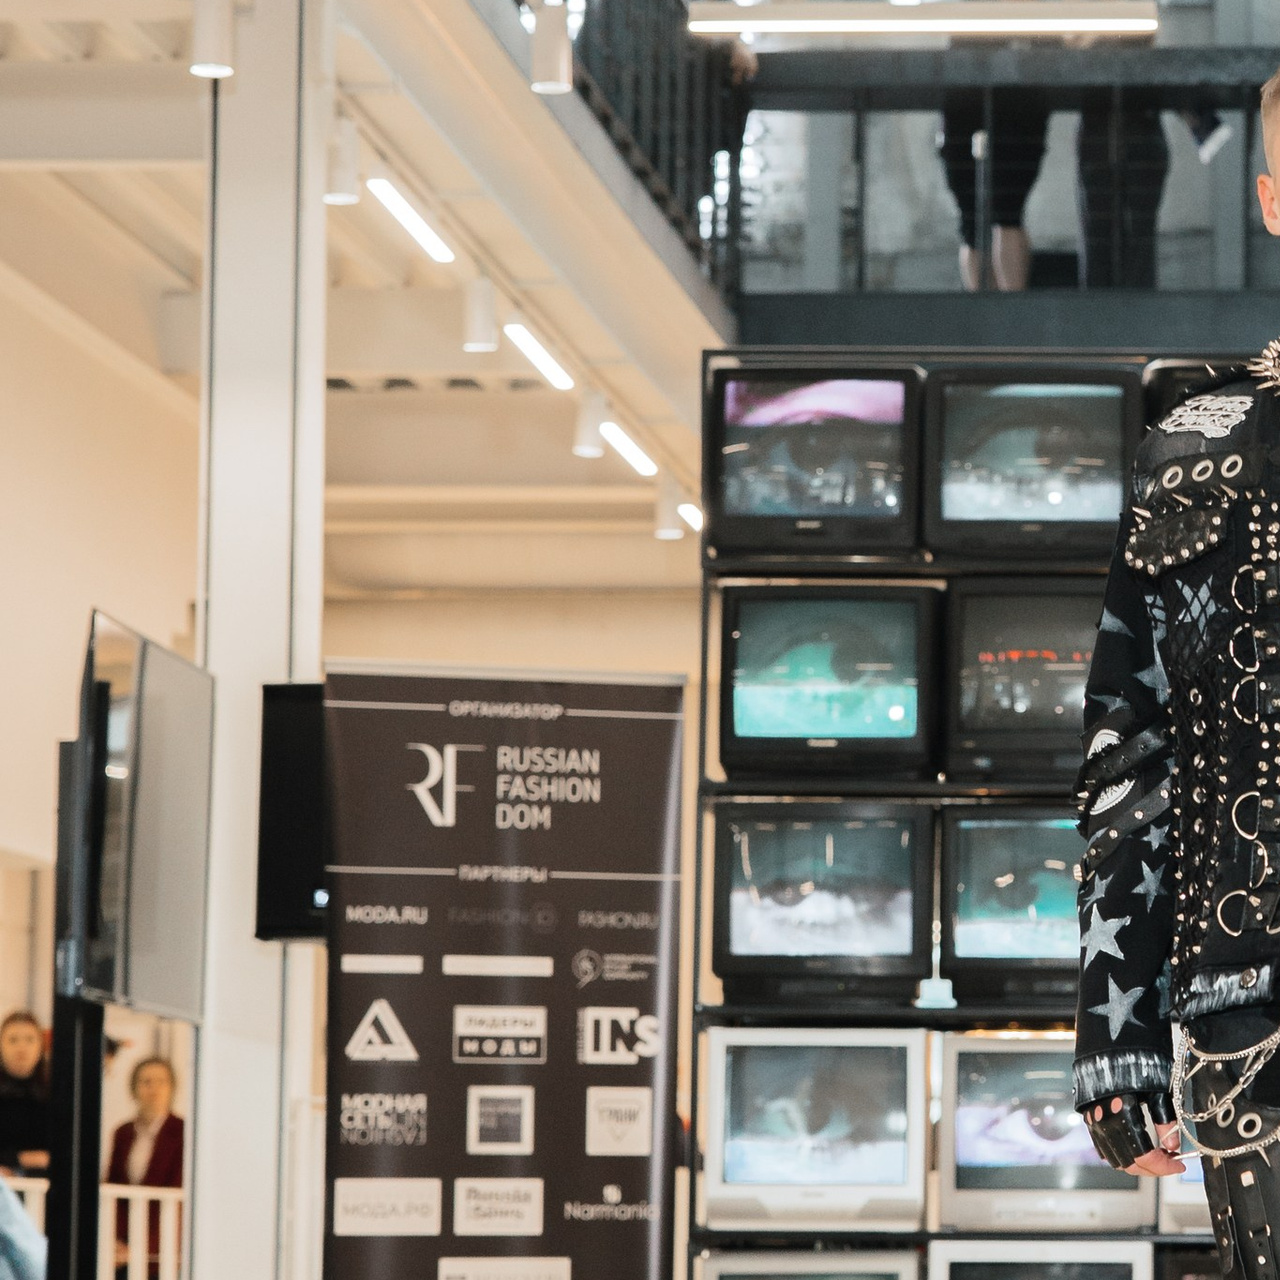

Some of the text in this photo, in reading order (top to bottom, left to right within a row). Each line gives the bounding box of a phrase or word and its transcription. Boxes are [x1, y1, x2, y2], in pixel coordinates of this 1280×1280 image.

[449, 700, 564, 720] ОРГАНИЗАТОР
[496, 746, 600, 774] RUSSIAN
[496, 774, 601, 803] FASHION
[495, 803, 551, 830] DOM
[458, 865, 548, 883] ПАРТНЕРЫ
[345, 905, 428, 925] MODA.RU
